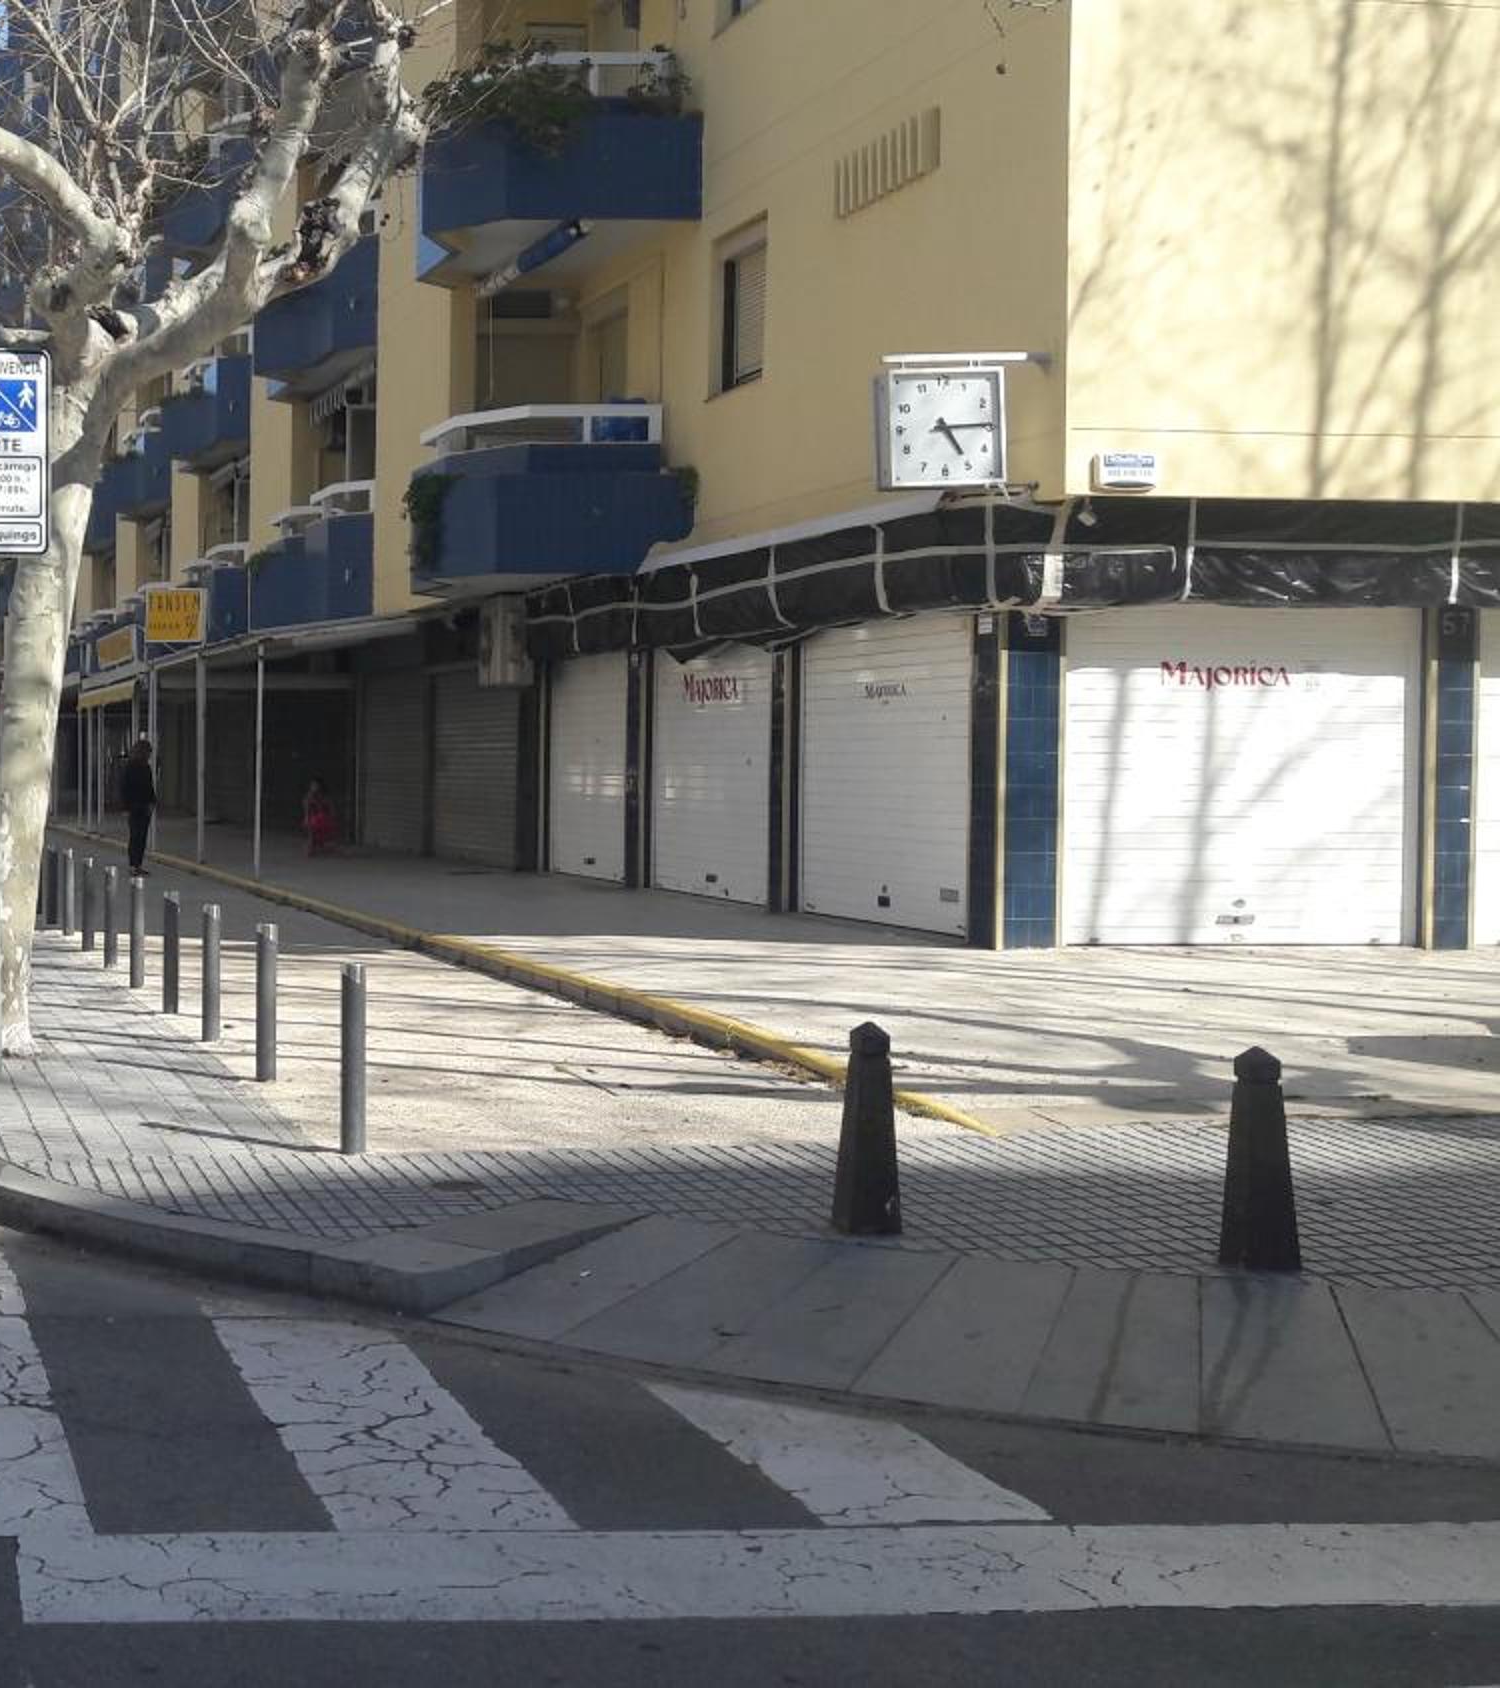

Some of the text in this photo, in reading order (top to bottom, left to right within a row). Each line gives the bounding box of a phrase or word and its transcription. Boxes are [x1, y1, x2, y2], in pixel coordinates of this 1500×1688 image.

[917, 384, 927, 393] 11
[980, 397, 987, 409] 2
[898, 403, 911, 414] 10
[895, 425, 904, 435] 9
[903, 444, 911, 455] 8
[980, 443, 988, 453] 4
[920, 462, 928, 472] 7
[941, 464, 949, 476] 6
[964, 461, 973, 471] 5
